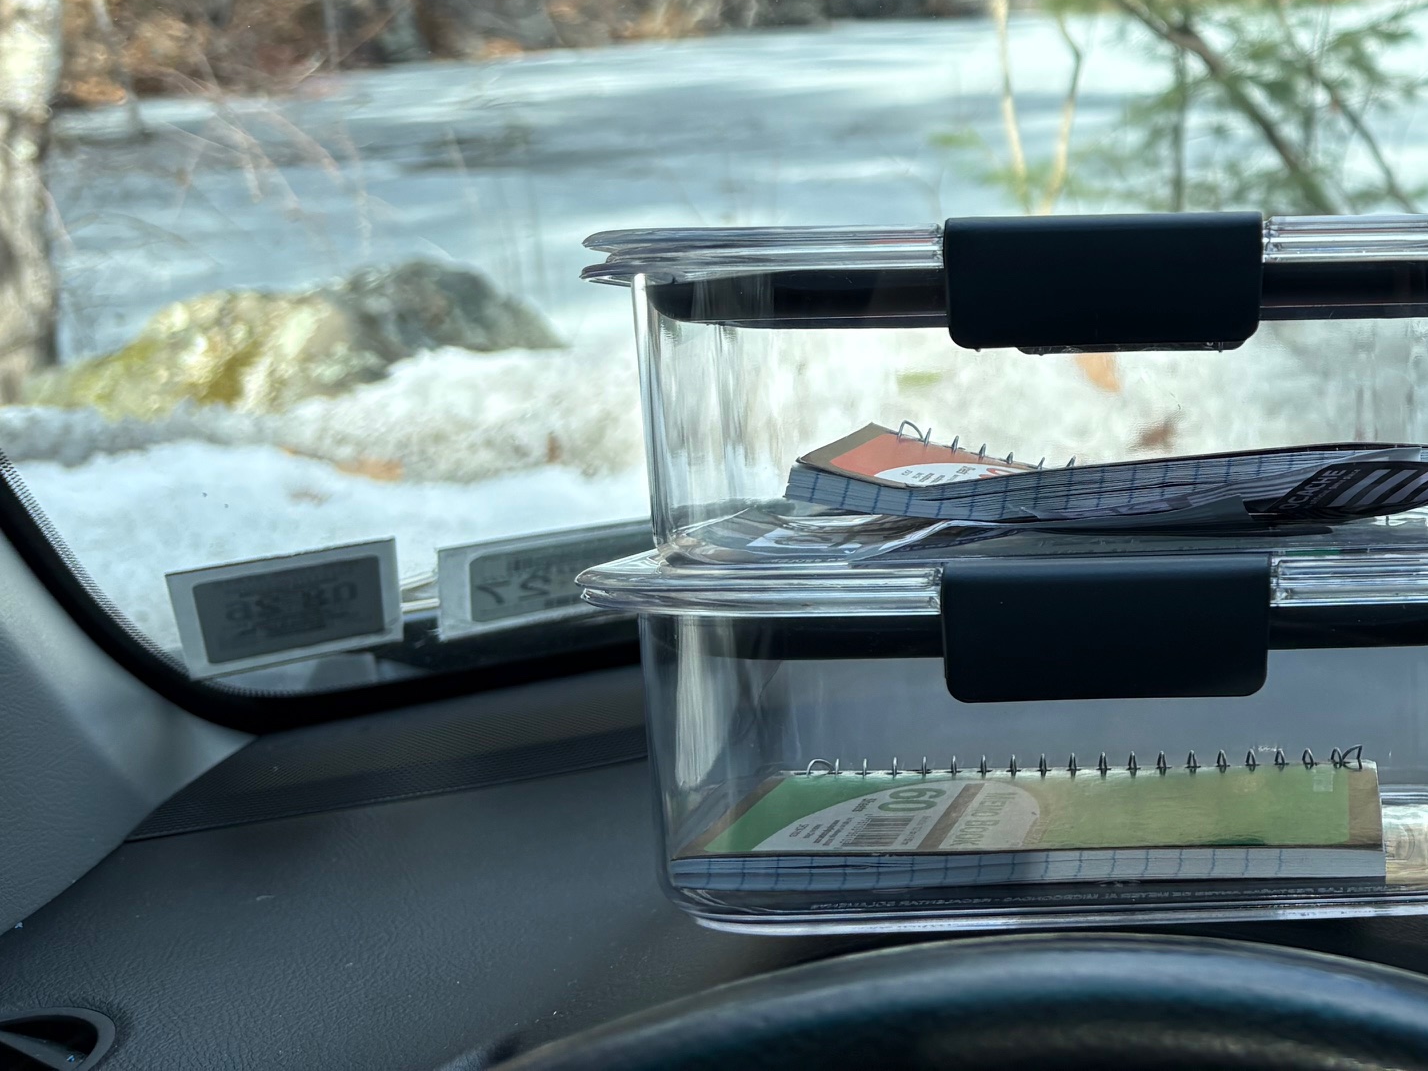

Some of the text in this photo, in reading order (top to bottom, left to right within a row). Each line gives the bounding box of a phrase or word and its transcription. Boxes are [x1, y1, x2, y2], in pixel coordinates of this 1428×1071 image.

[1278, 469, 1347, 510] OCACHE
[877, 787, 948, 813] 60
[949, 792, 1018, 847] MEMO BOOK
